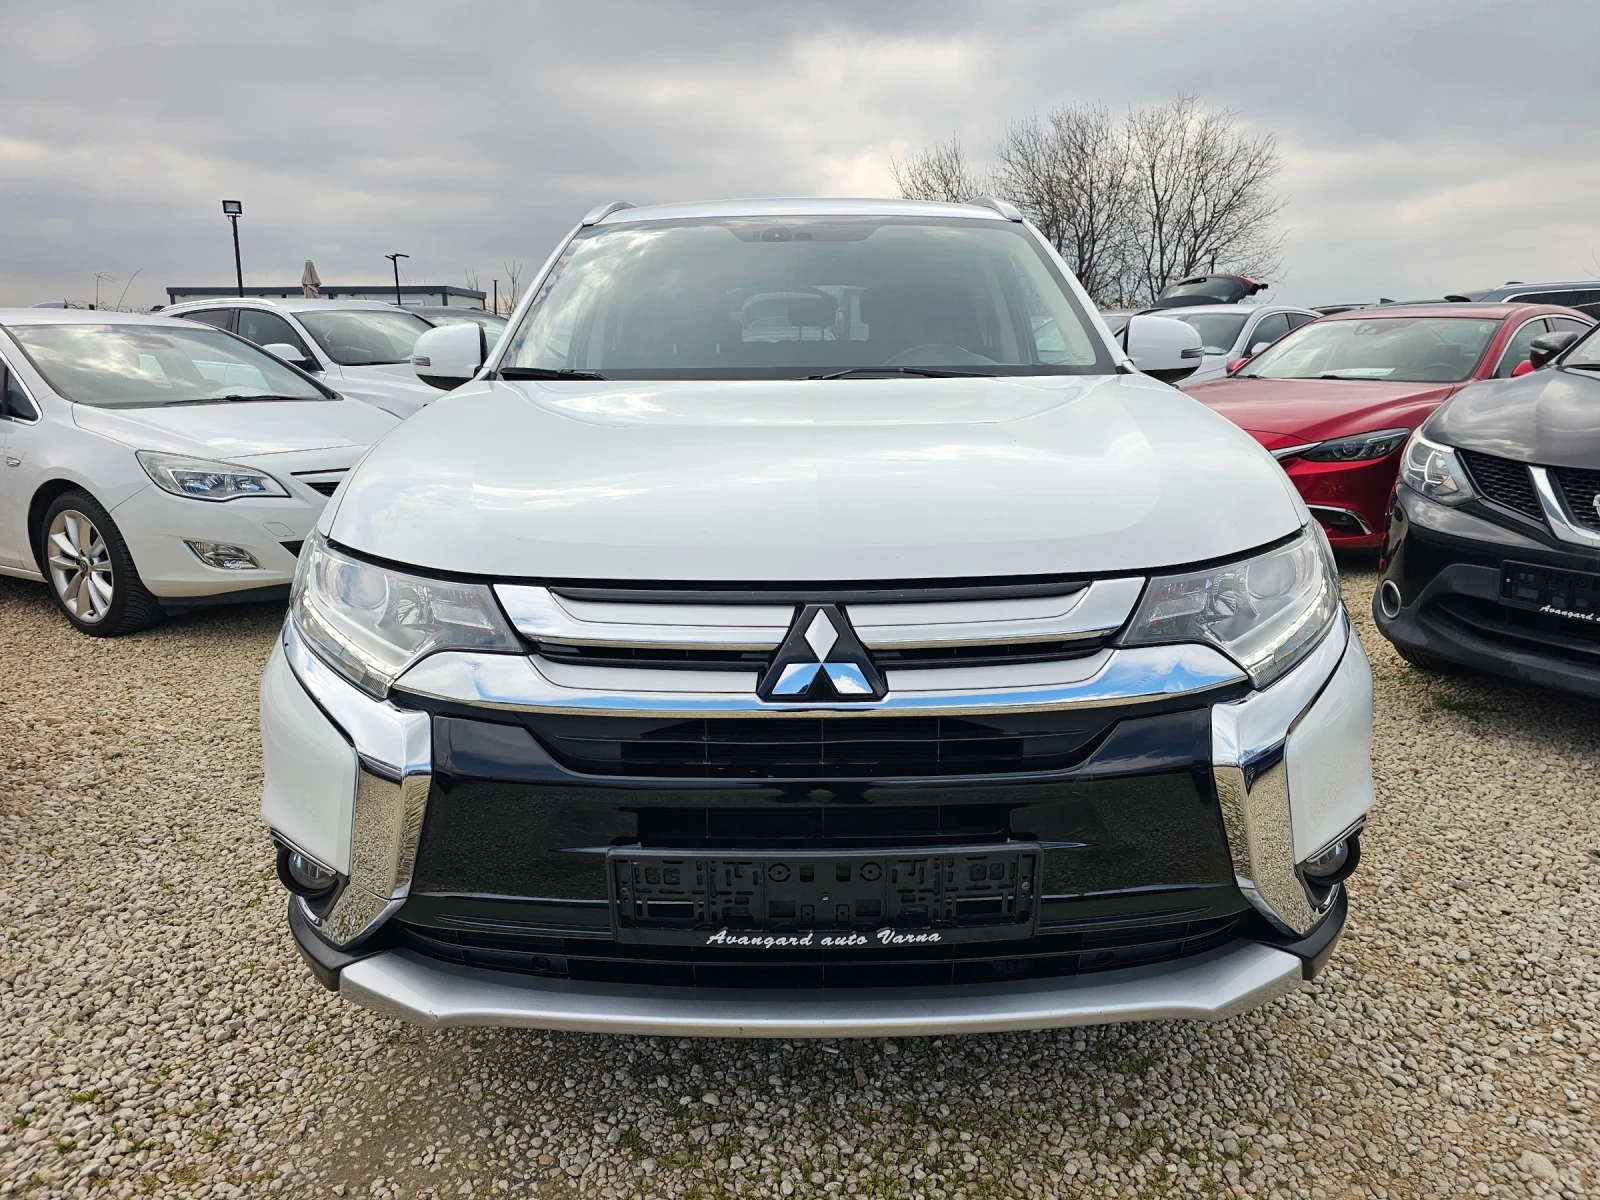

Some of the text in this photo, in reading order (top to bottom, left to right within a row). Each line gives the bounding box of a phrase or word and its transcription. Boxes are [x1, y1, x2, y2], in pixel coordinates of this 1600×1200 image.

[1539, 604, 1594, 620] Avangard
[706, 928, 942, 948] Avangard auto Varna
